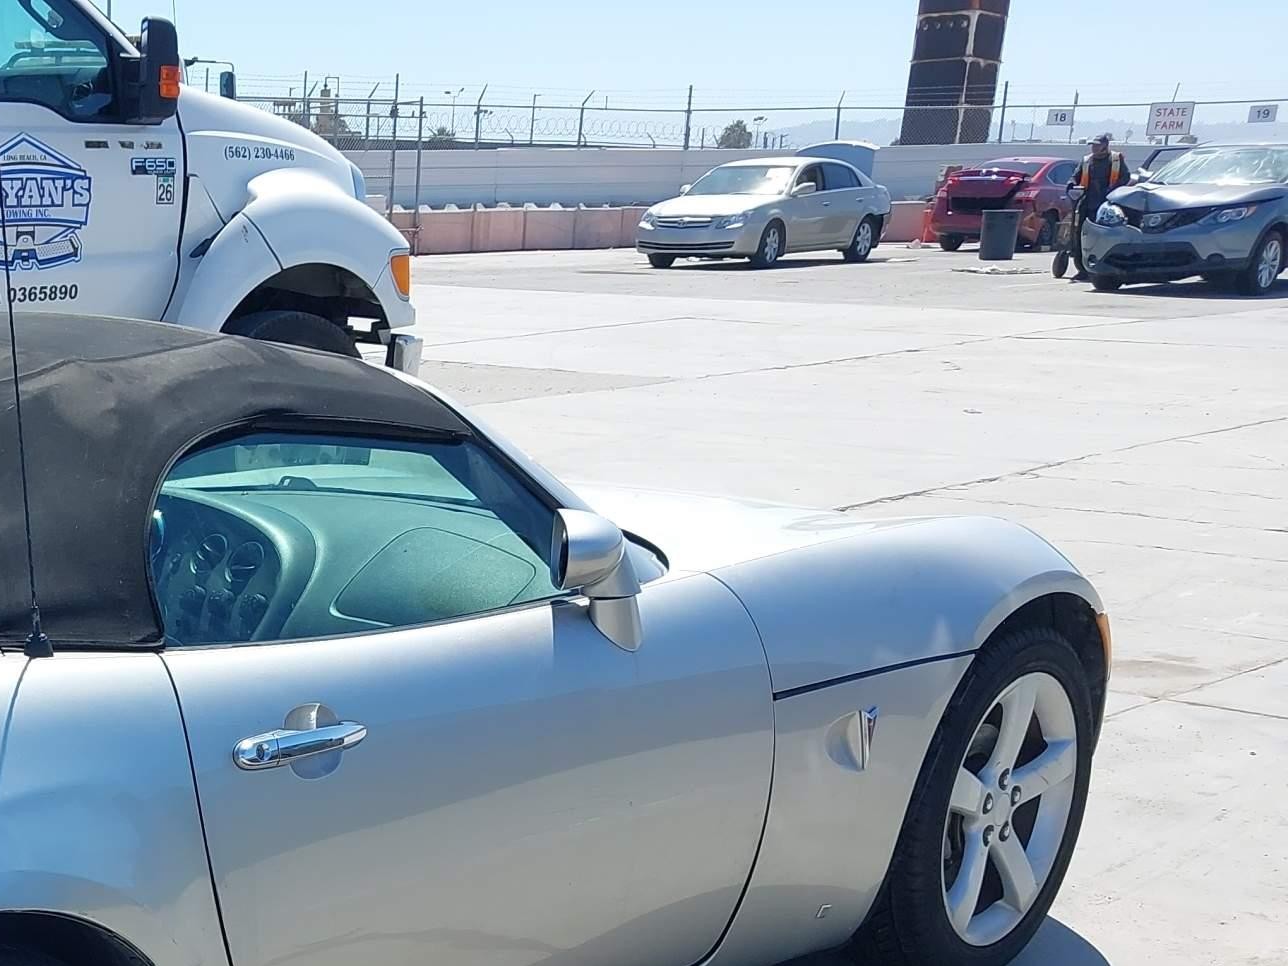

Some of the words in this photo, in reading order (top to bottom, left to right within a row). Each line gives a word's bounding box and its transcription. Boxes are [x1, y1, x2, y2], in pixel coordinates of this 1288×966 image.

[1053, 112, 1067, 122] 18
[1155, 107, 1188, 117] STATE
[1256, 108, 1271, 119] 19
[1154, 120, 1184, 130] FARM
[224, 146, 251, 160] (562)
[253, 147, 295, 161] 230-4466
[158, 183, 173, 202] 26
[3, 209, 33, 219] OWING
[35, 208, 52, 218] INC.
[9, 284, 79, 304] 0365890
